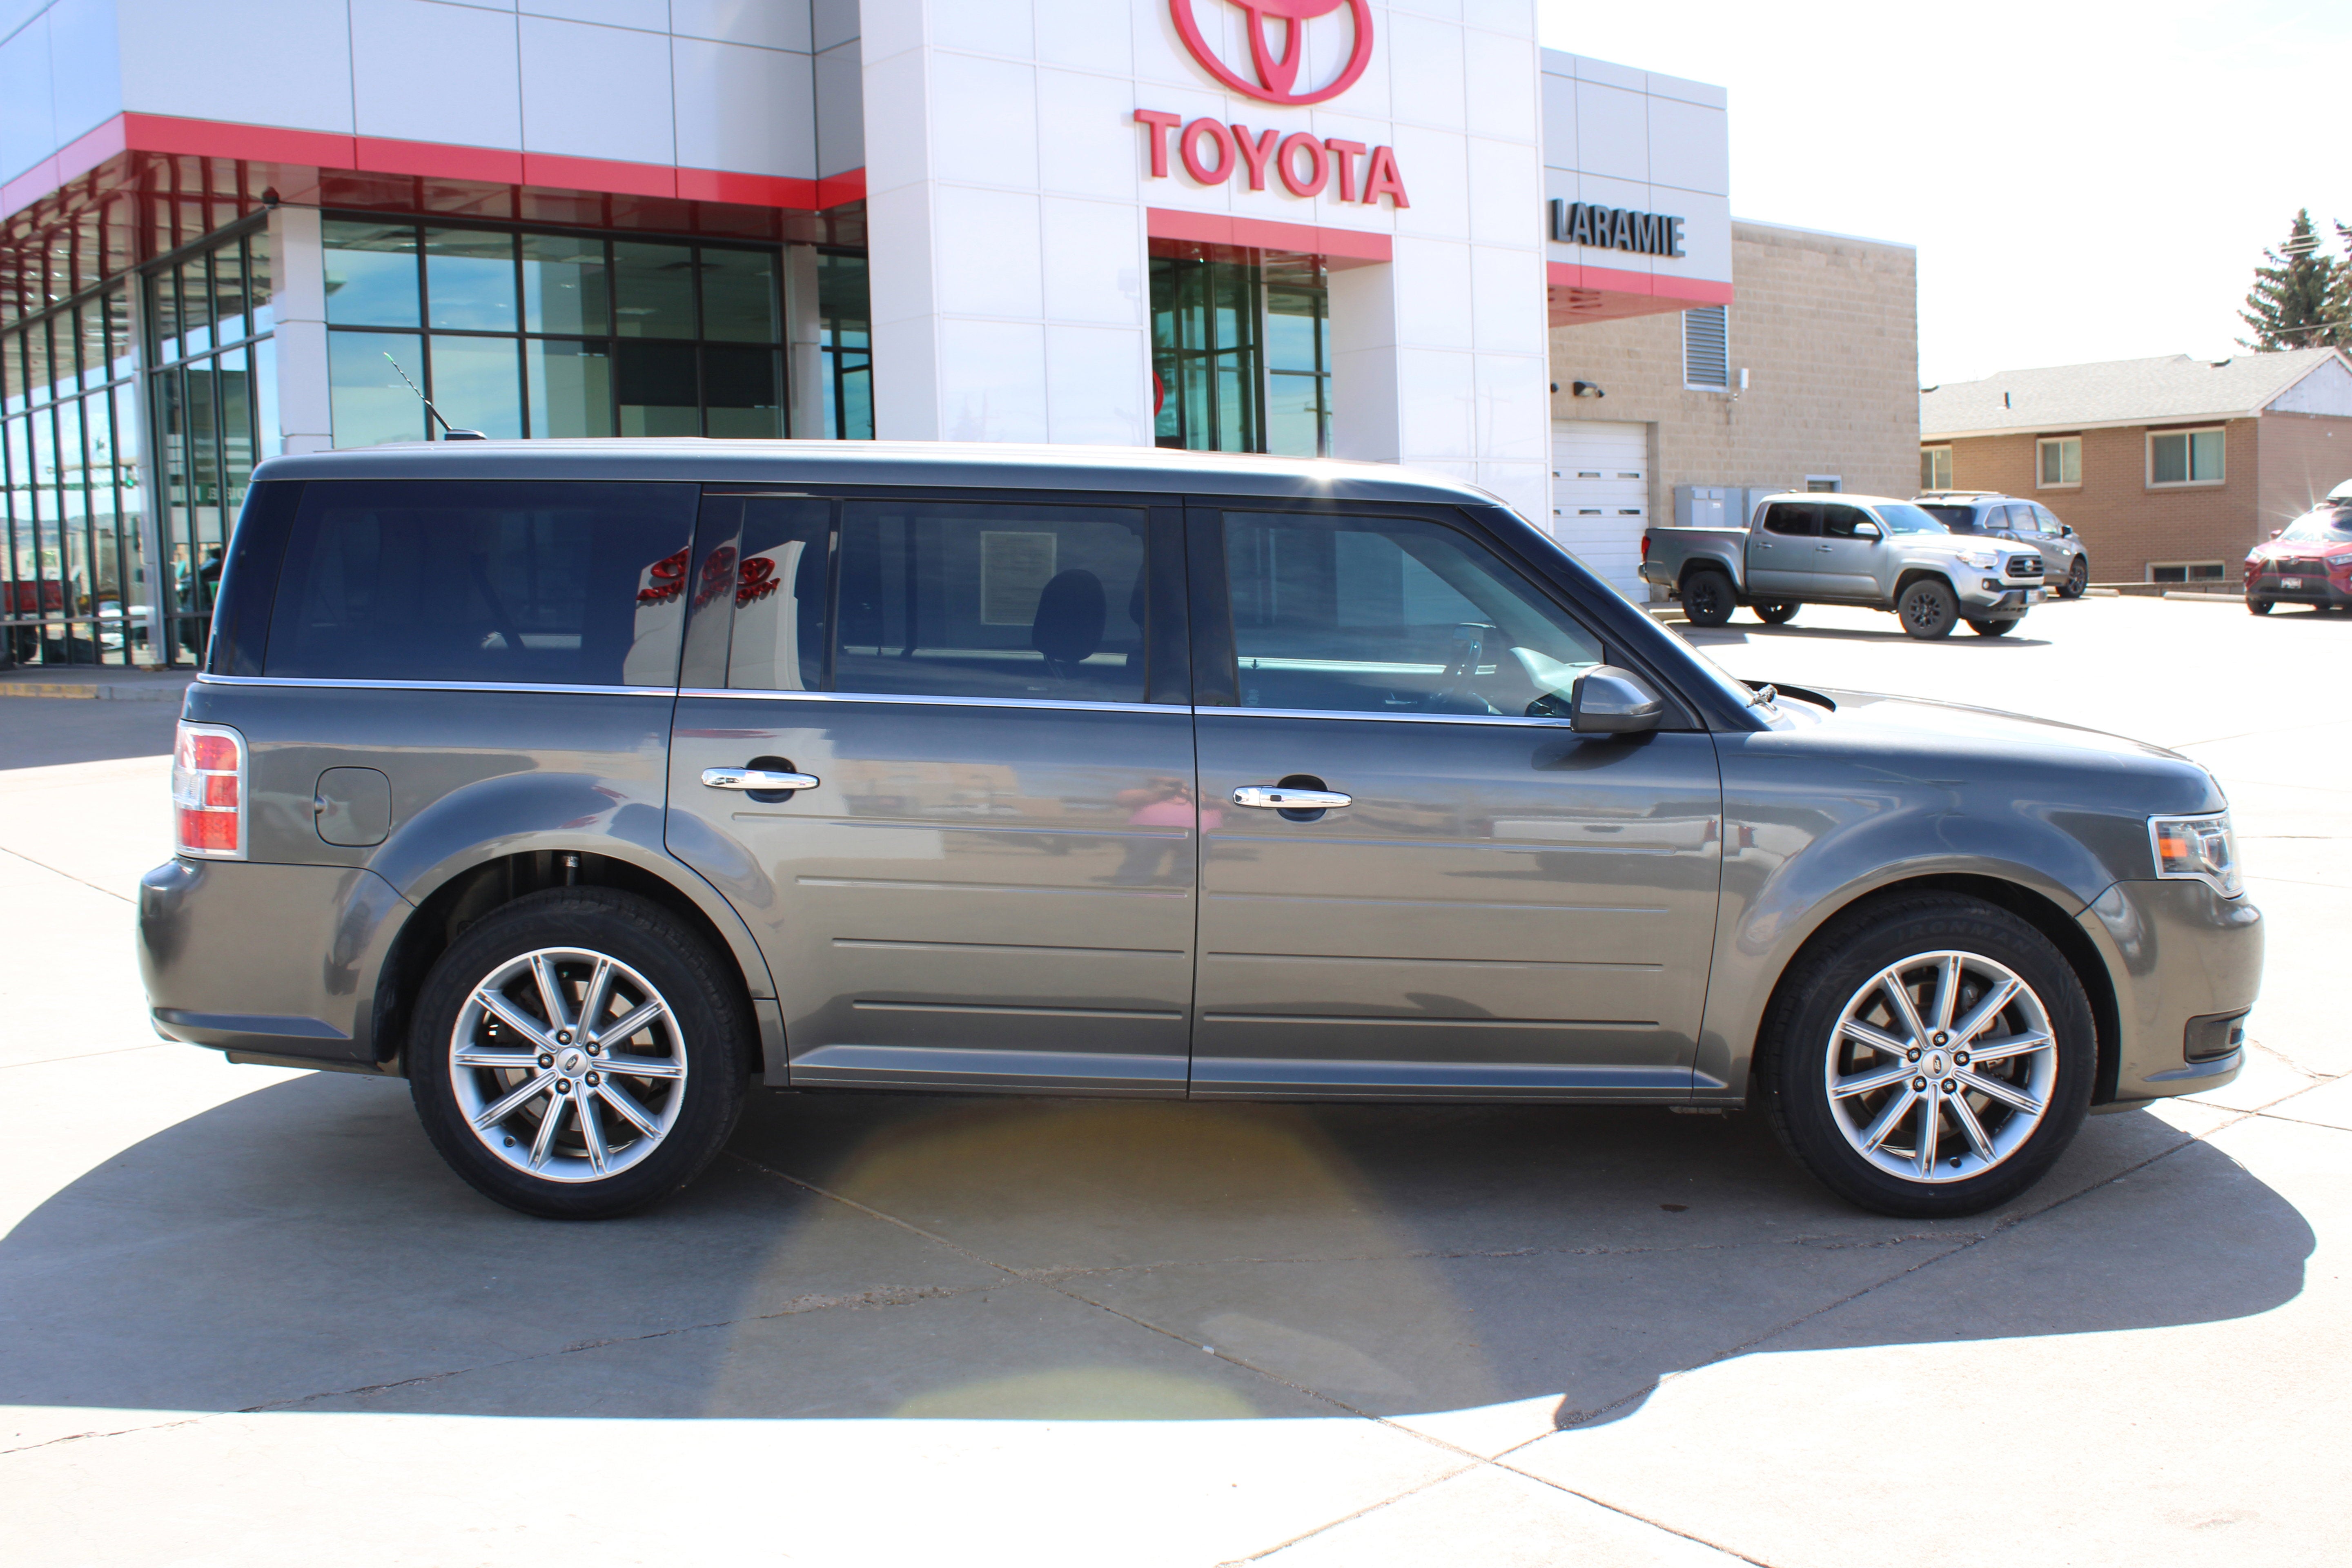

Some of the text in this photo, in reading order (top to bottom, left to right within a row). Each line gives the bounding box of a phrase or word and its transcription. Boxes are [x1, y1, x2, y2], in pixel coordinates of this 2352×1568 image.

[1134, 109, 1410, 208] TOYOTA
[1550, 198, 1685, 257] LARAMIE
[1897, 921, 2032, 953] IRONMAN
